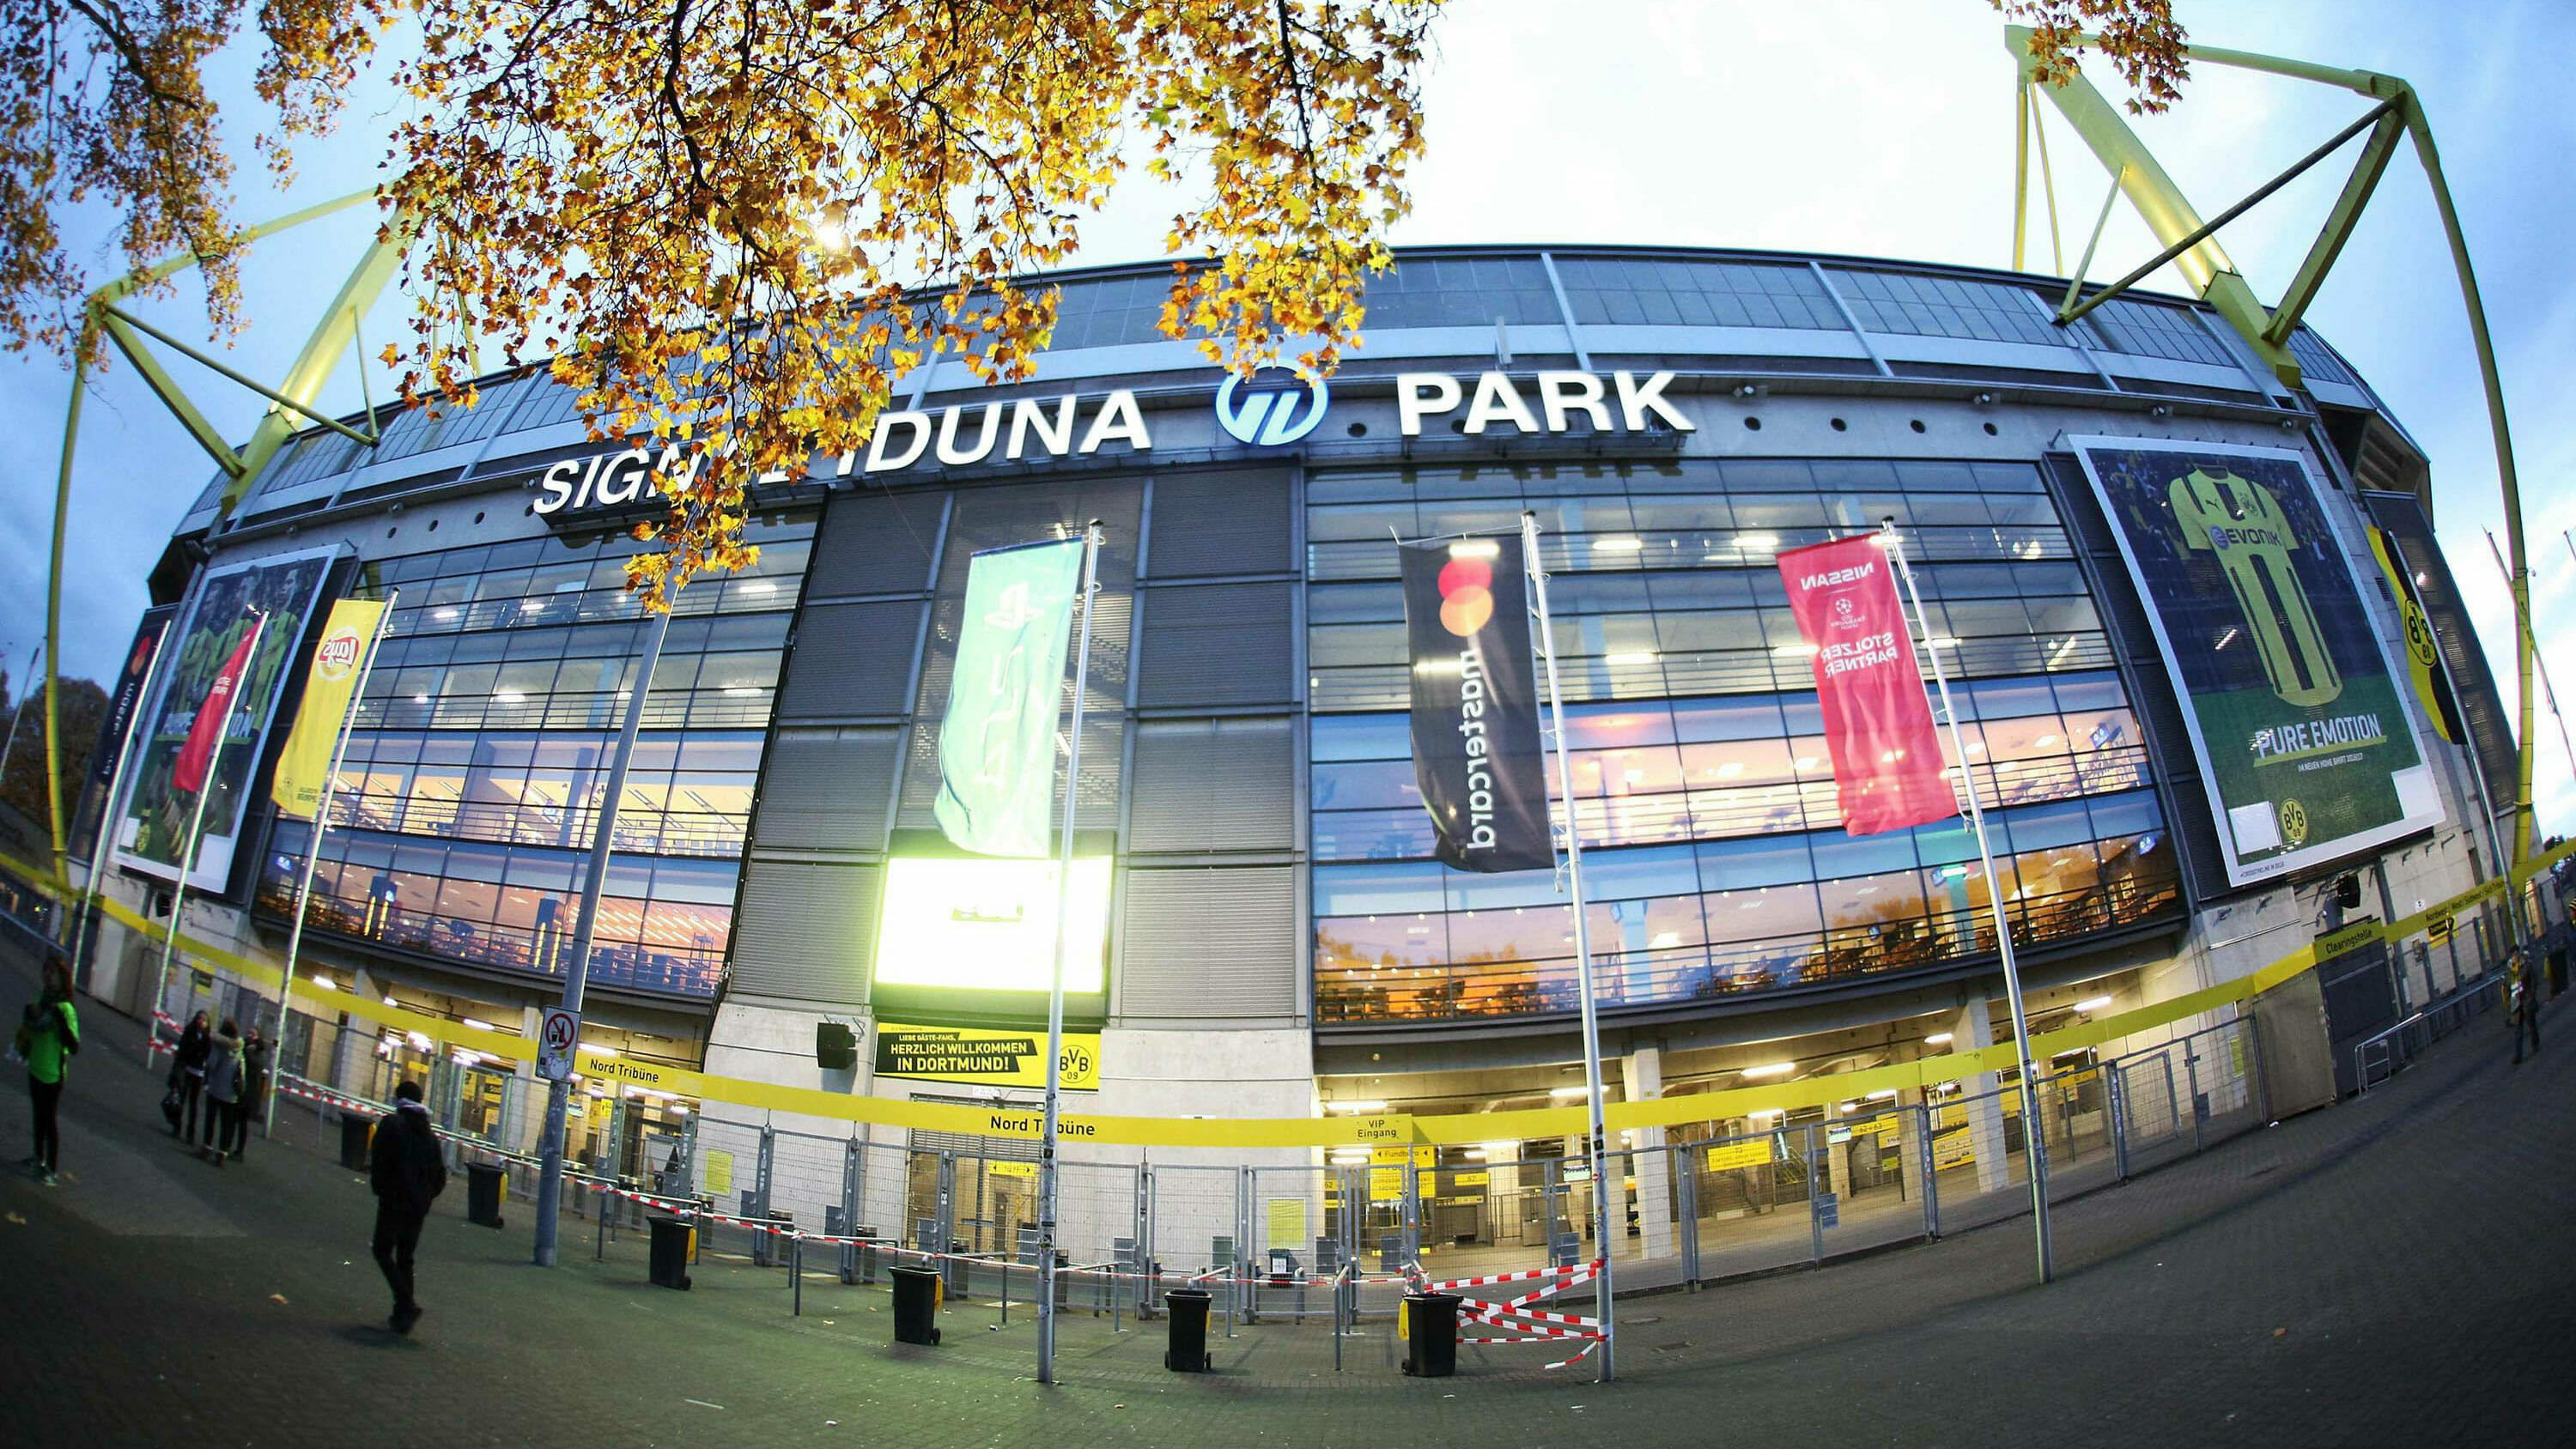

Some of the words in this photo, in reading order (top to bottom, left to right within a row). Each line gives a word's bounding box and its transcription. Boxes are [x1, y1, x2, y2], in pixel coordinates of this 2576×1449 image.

[532, 441, 802, 514] SIGN
[1396, 370, 1697, 436] PARK
[2255, 723, 2310, 759] PURE
[2310, 713, 2382, 747] EMOTION
[2283, 803, 2306, 831] BVB
[2325, 928, 2372, 955] Clearingstelle
[890, 1042, 945, 1055] HERZLICH
[946, 1041, 1028, 1055] WILLKOMMEN
[590, 1058, 616, 1075] Nord
[618, 1064, 659, 1083] Tribüne
[896, 1057, 914, 1071] IN
[916, 1056, 1010, 1071] DORTMUND!
[1060, 1048, 1090, 1072] BVB
[1066, 1071, 1078, 1081] 09
[990, 1115, 1029, 1132] Nord
[1033, 1119, 1096, 1136] Tbüne
[1357, 1129, 1397, 1139] Eingang
[1368, 1119, 1385, 1129] VIP
